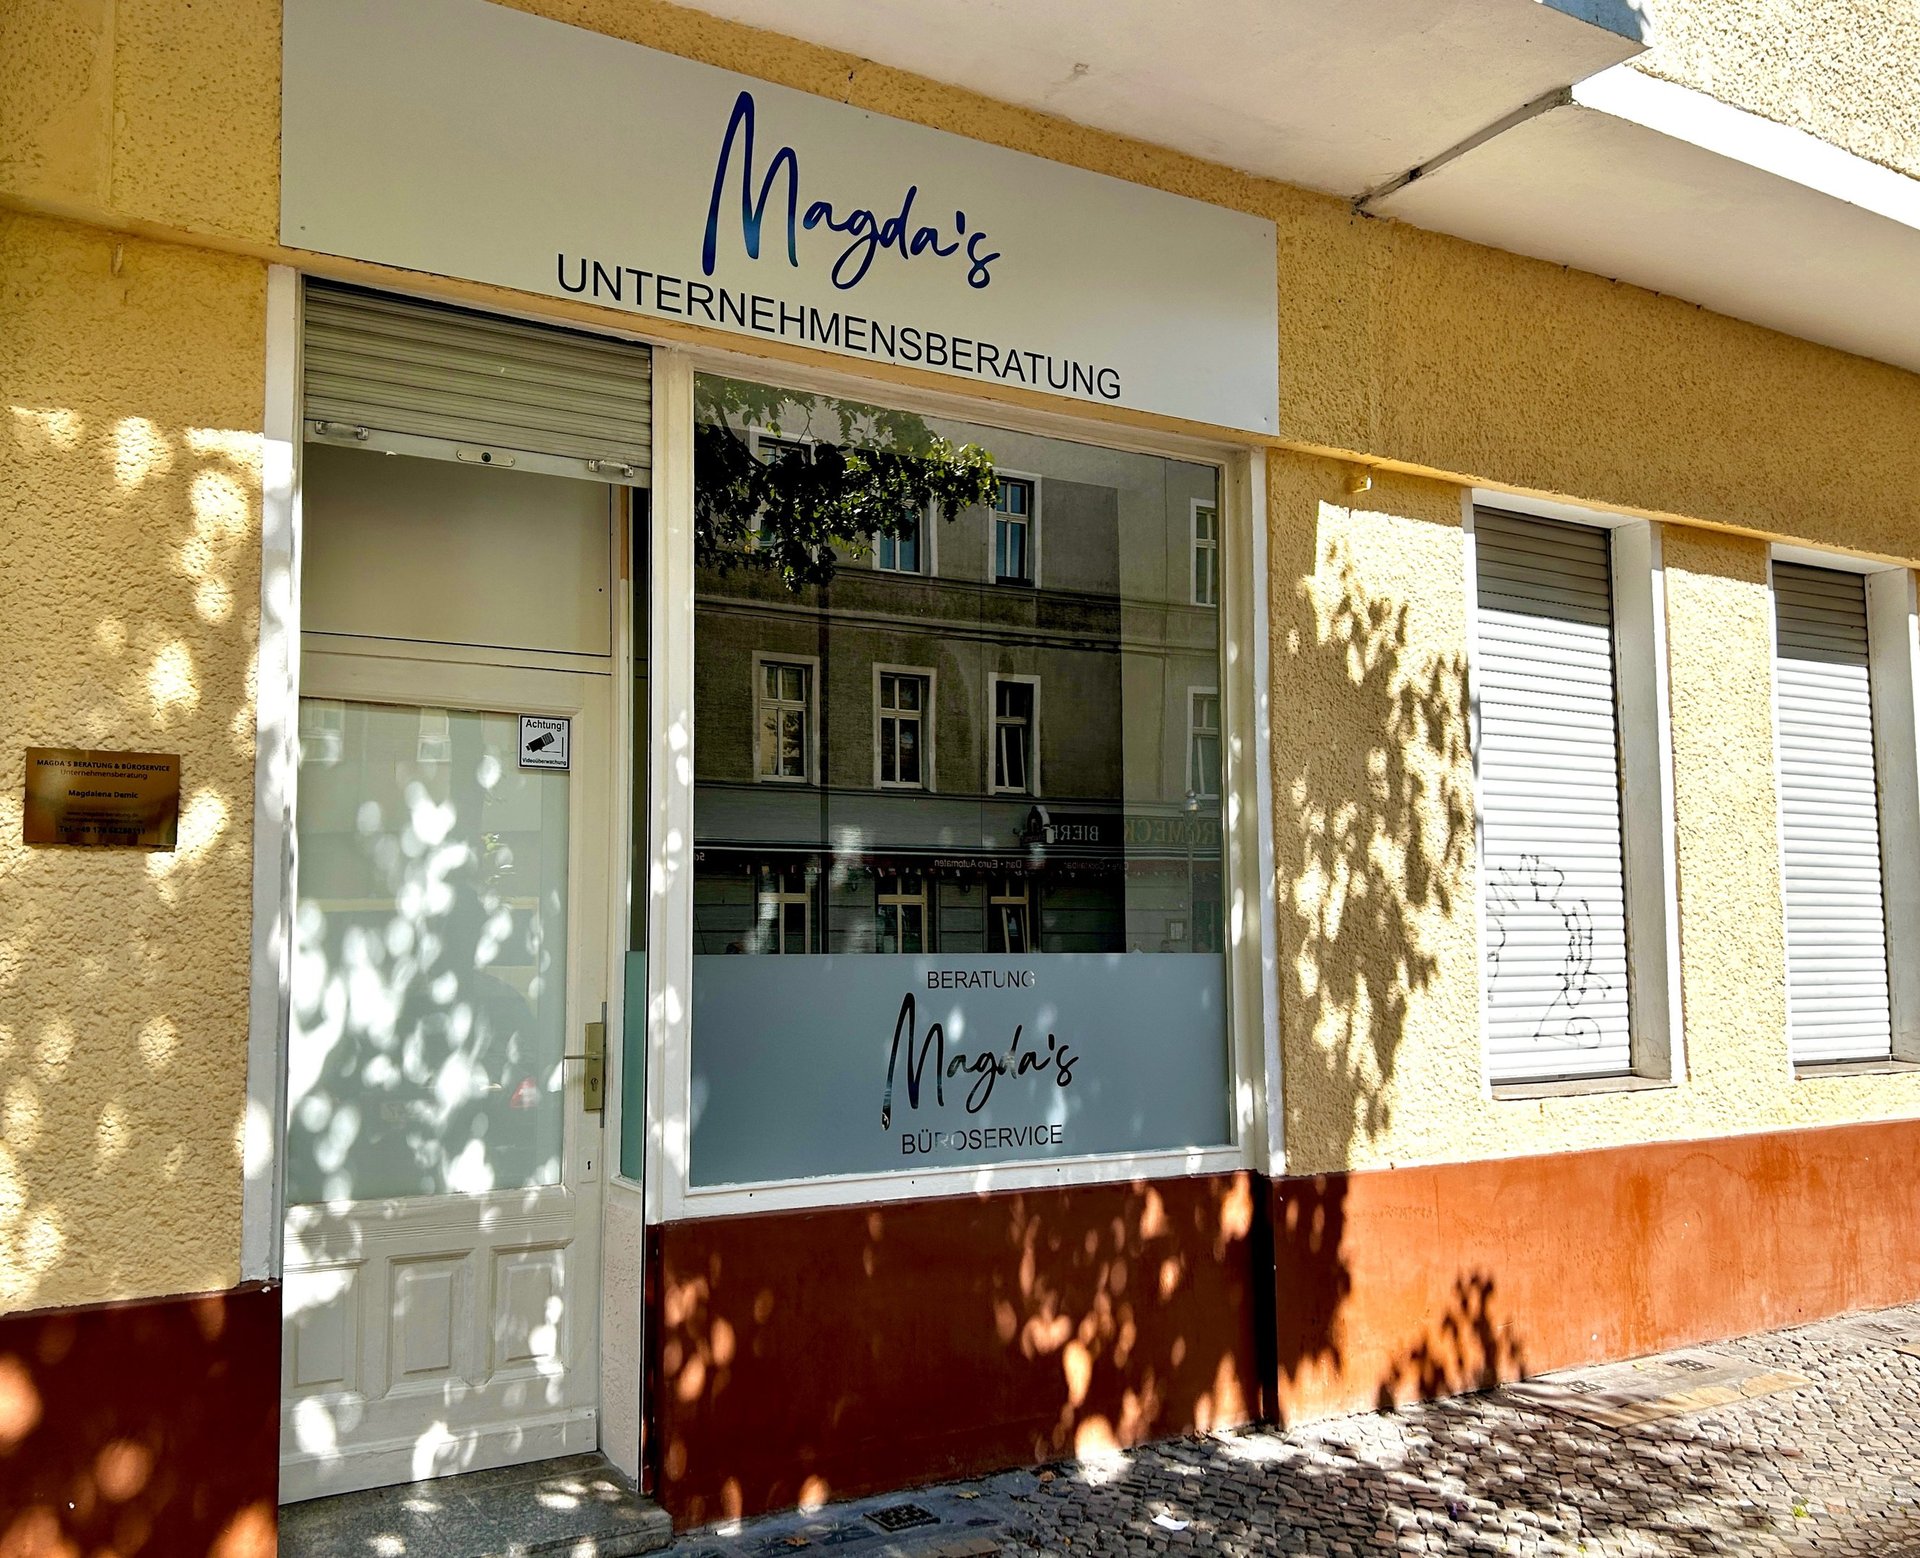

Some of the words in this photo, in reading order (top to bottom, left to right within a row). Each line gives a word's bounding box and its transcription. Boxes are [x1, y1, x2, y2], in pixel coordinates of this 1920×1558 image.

[701, 90, 1001, 291] Magda's
[556, 252, 1122, 401] UNTERNEHMENSBERATUNG
[525, 719, 565, 732] Achtung!
[60, 769, 148, 780] Unternehmensberatung
[73, 761, 113, 769] BERATUNG
[121, 762, 170, 772] BÜROSERVICE
[68, 789, 112, 799] Magdalena
[927, 970, 1036, 989] BERATUNG
[881, 992, 1079, 1131] Magda's
[902, 1124, 1063, 1154] BÜROSERVICE
